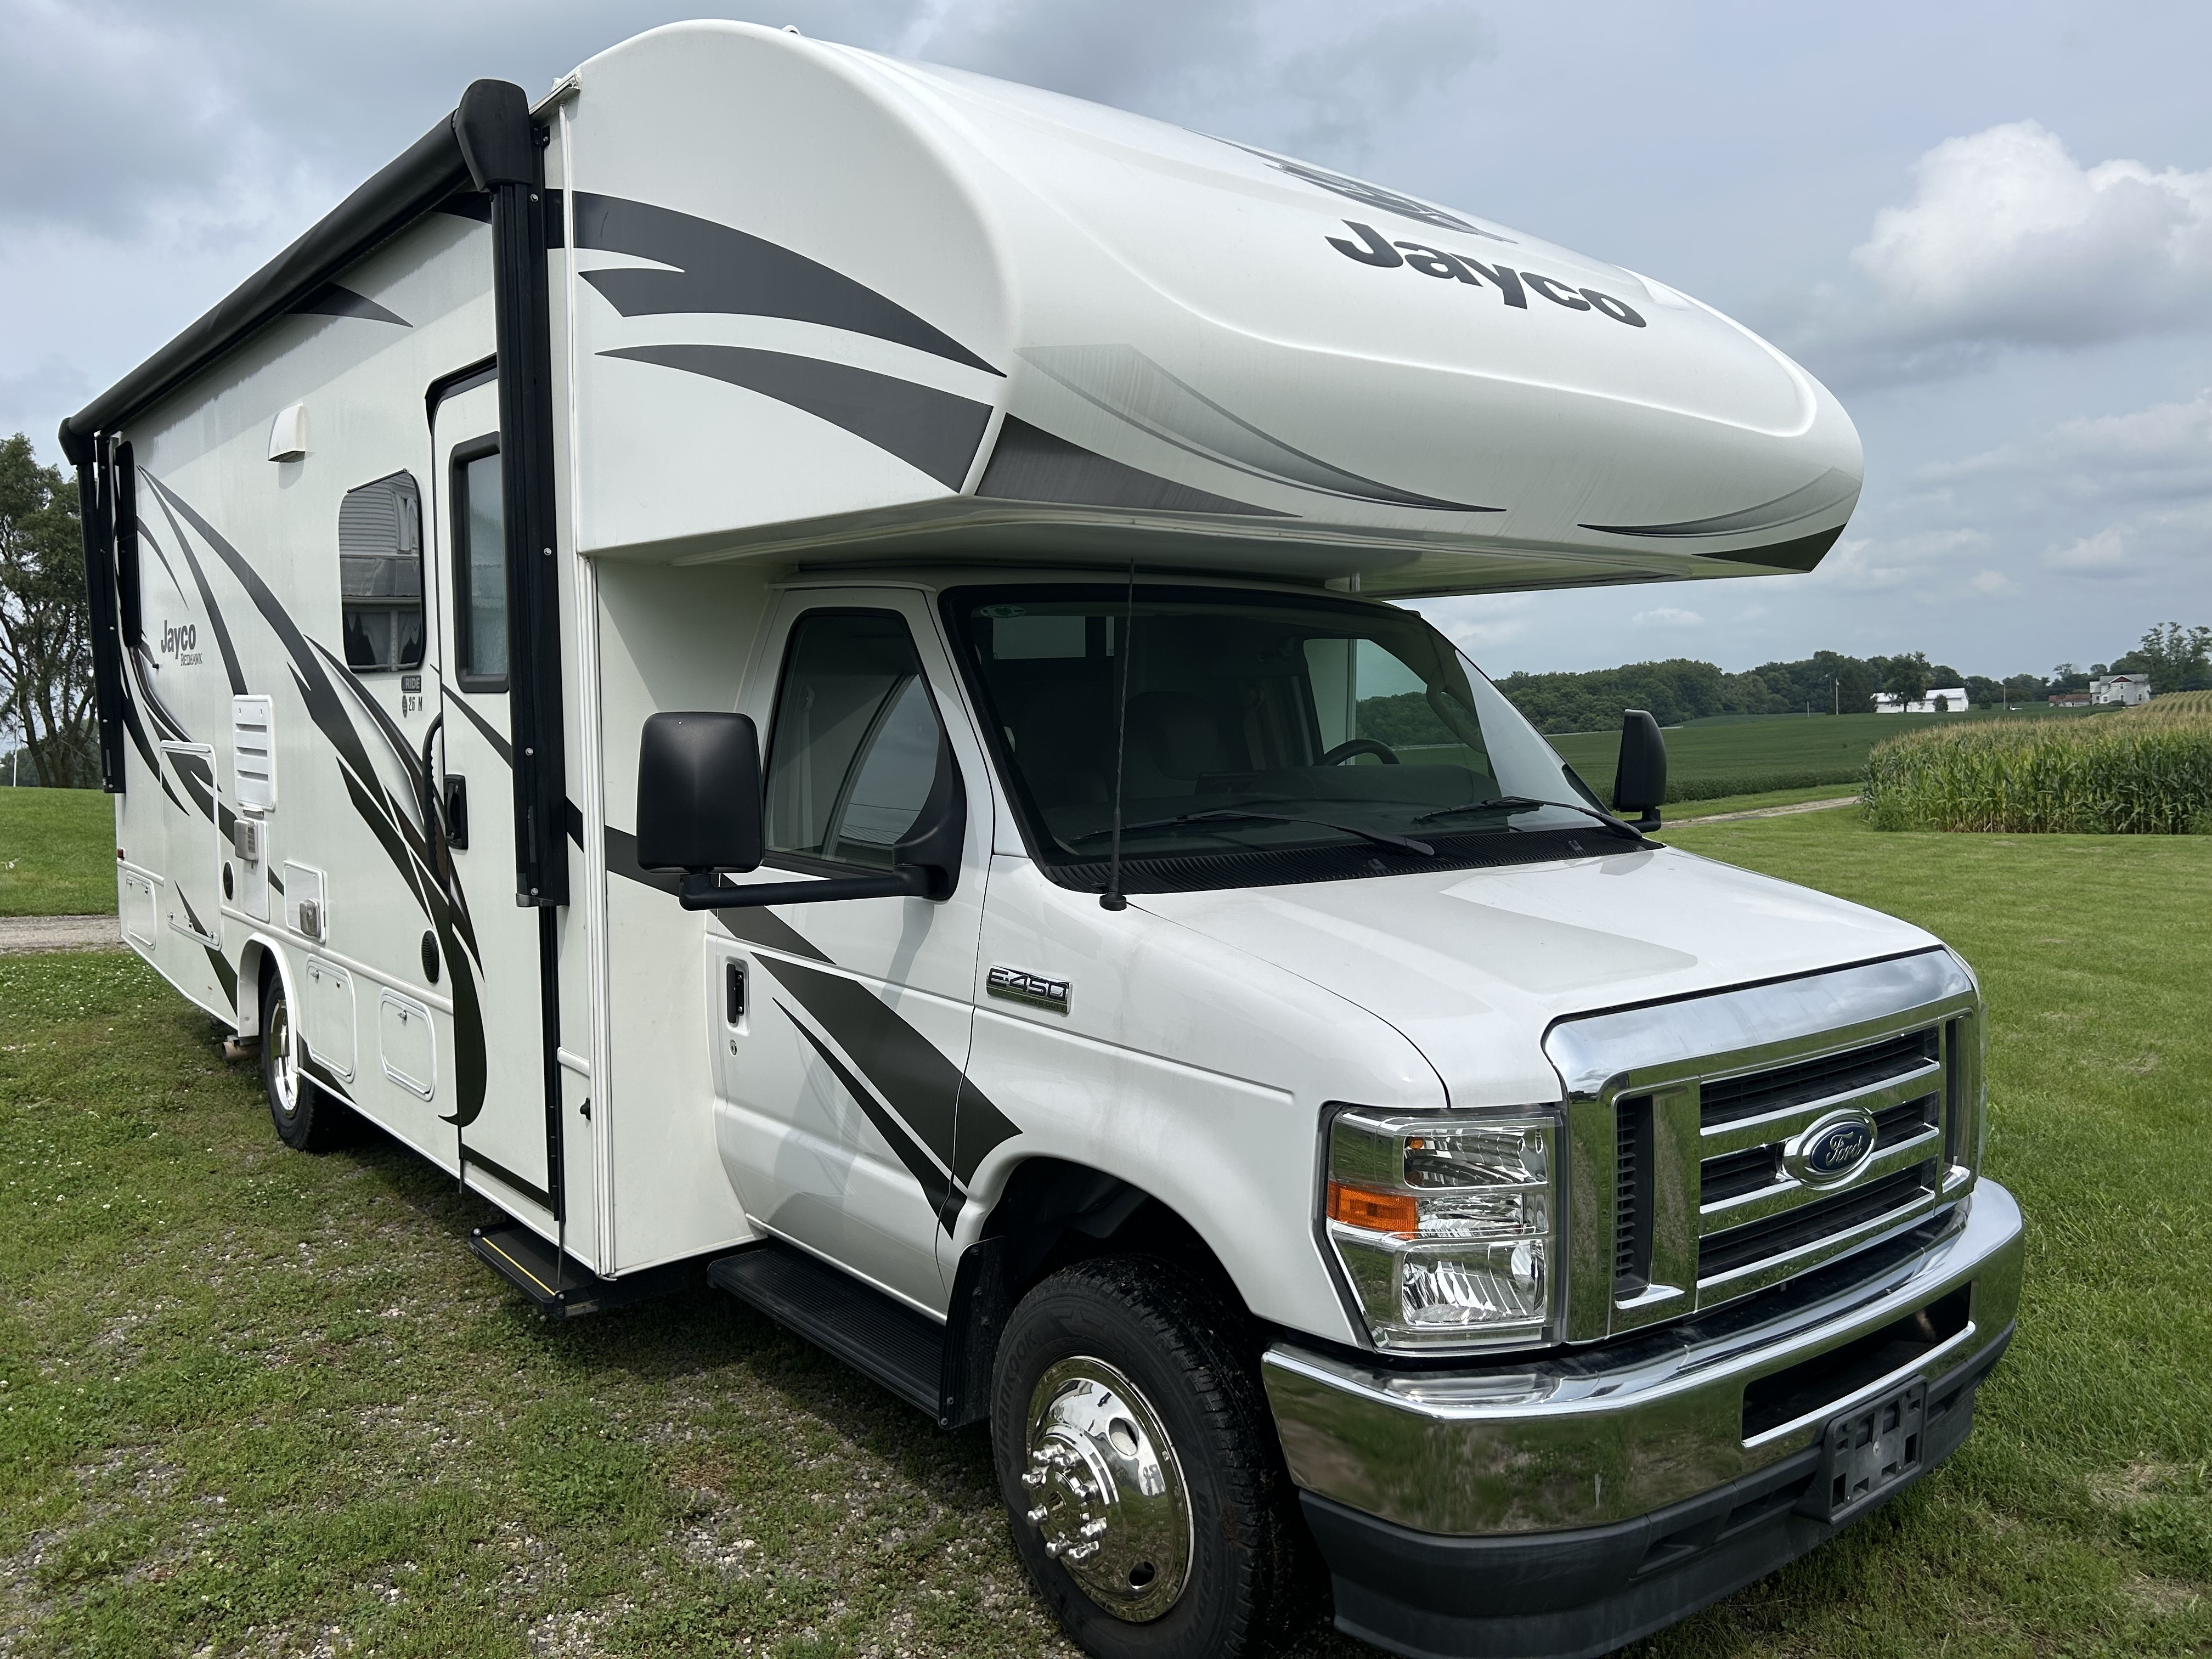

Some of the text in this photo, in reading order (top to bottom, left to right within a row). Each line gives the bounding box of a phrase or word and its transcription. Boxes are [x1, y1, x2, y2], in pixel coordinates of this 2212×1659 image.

[1324, 219, 1647, 328] Jayco
[161, 619, 196, 659] Jayco
[1022, 997, 1065, 1011] SUPER DUTY
[1826, 1131, 1863, 1166] Ford
